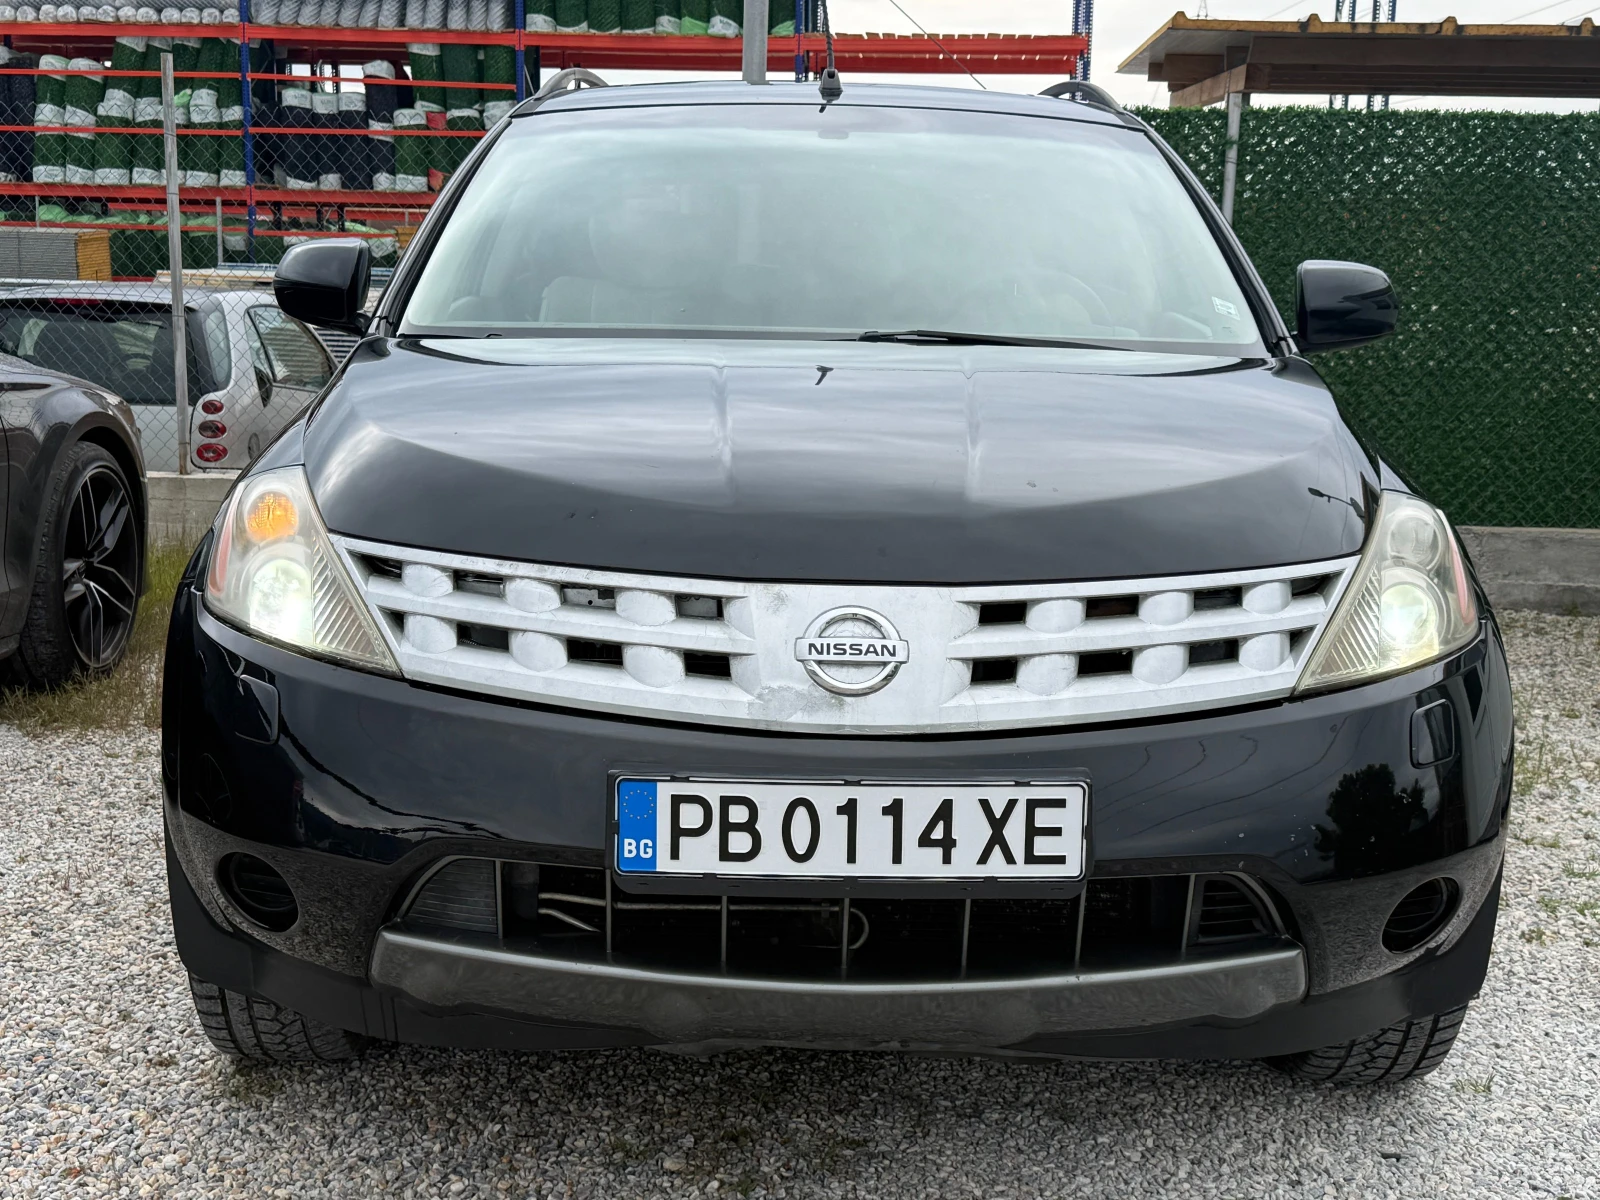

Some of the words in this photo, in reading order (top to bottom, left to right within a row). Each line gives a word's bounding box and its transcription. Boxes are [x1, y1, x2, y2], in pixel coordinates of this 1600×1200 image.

[808, 642, 897, 658] NISSAN
[669, 794, 763, 862] PB
[781, 796, 957, 865] 0114
[976, 797, 1067, 865] XE
[623, 838, 653, 859] BG
